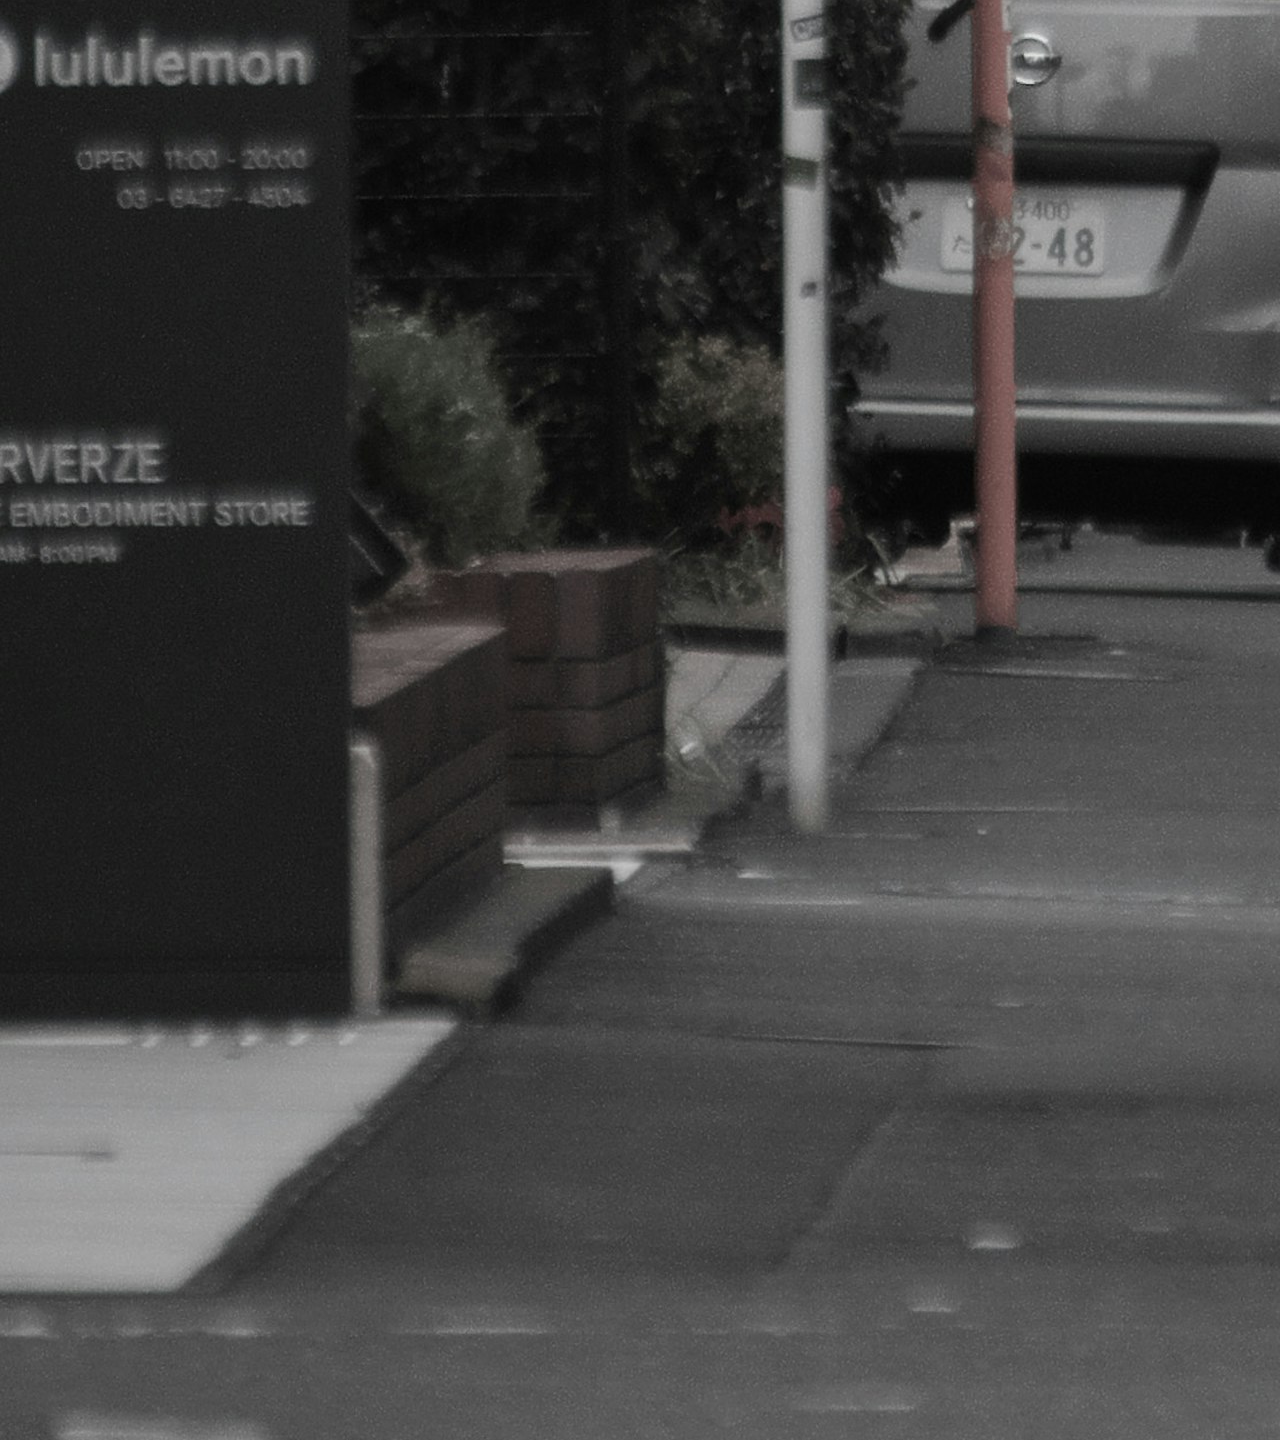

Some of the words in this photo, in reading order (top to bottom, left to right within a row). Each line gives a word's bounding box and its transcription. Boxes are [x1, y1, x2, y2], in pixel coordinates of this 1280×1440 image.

[34, 35, 308, 87] lululemon
[76, 149, 145, 171] OPEN
[0, 442, 163, 484] RVERZE
[10, 500, 207, 528] EMBODIMENT
[213, 500, 309, 528] STORE
